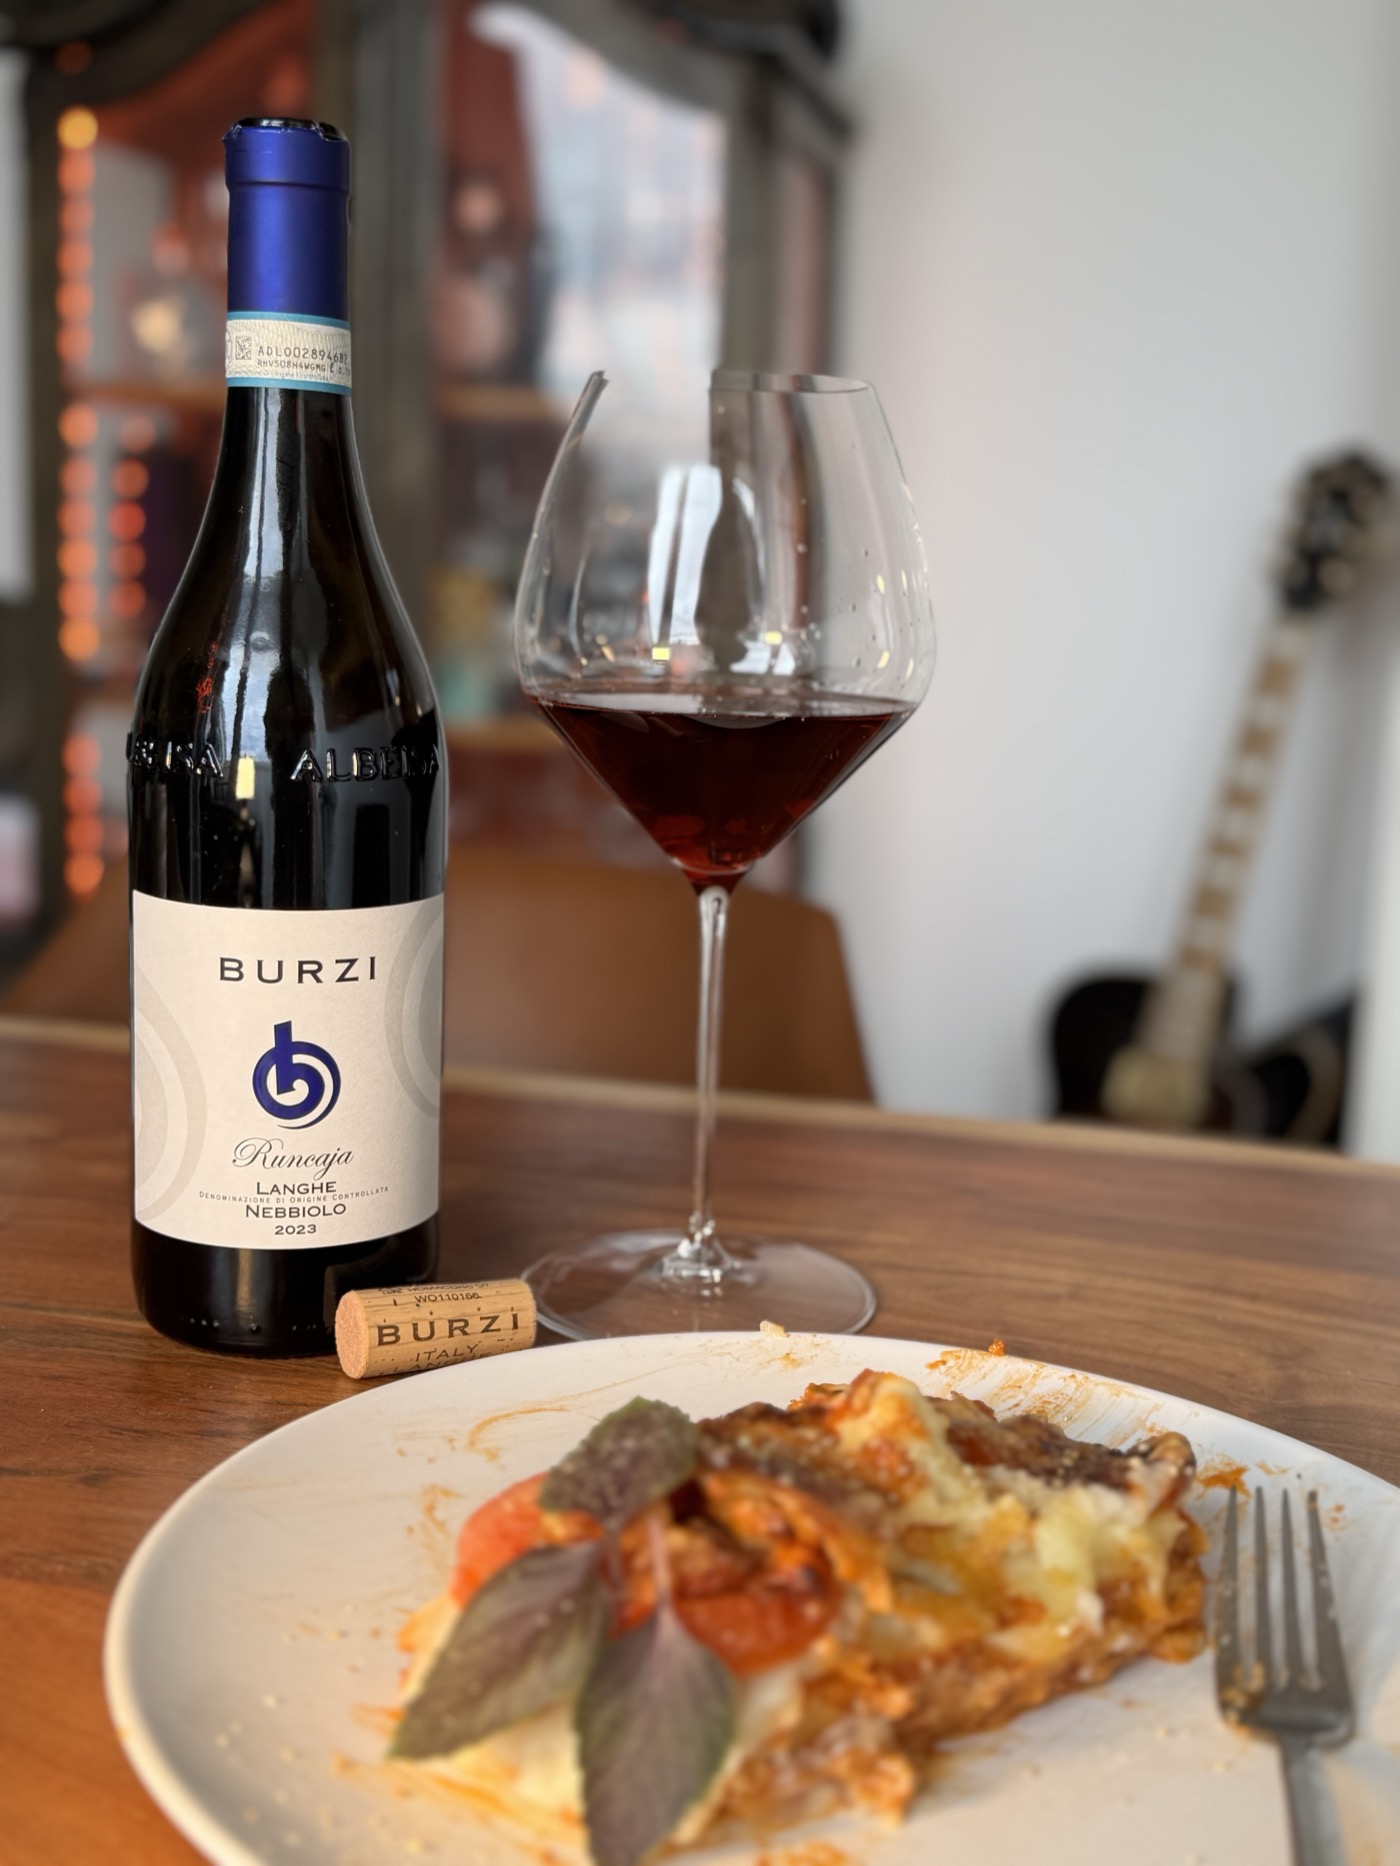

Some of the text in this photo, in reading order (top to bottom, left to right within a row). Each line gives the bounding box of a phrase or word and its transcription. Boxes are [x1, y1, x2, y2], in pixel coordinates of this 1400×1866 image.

[219, 956, 376, 984] BURZI
[232, 1137, 355, 1181] Runcaja
[256, 1181, 337, 1196] LANGHE
[245, 1203, 347, 1219] NEBBIOLO
[274, 1223, 317, 1236] 2023
[377, 1312, 519, 1347] BURZI
[415, 1344, 479, 1363] ITALY
